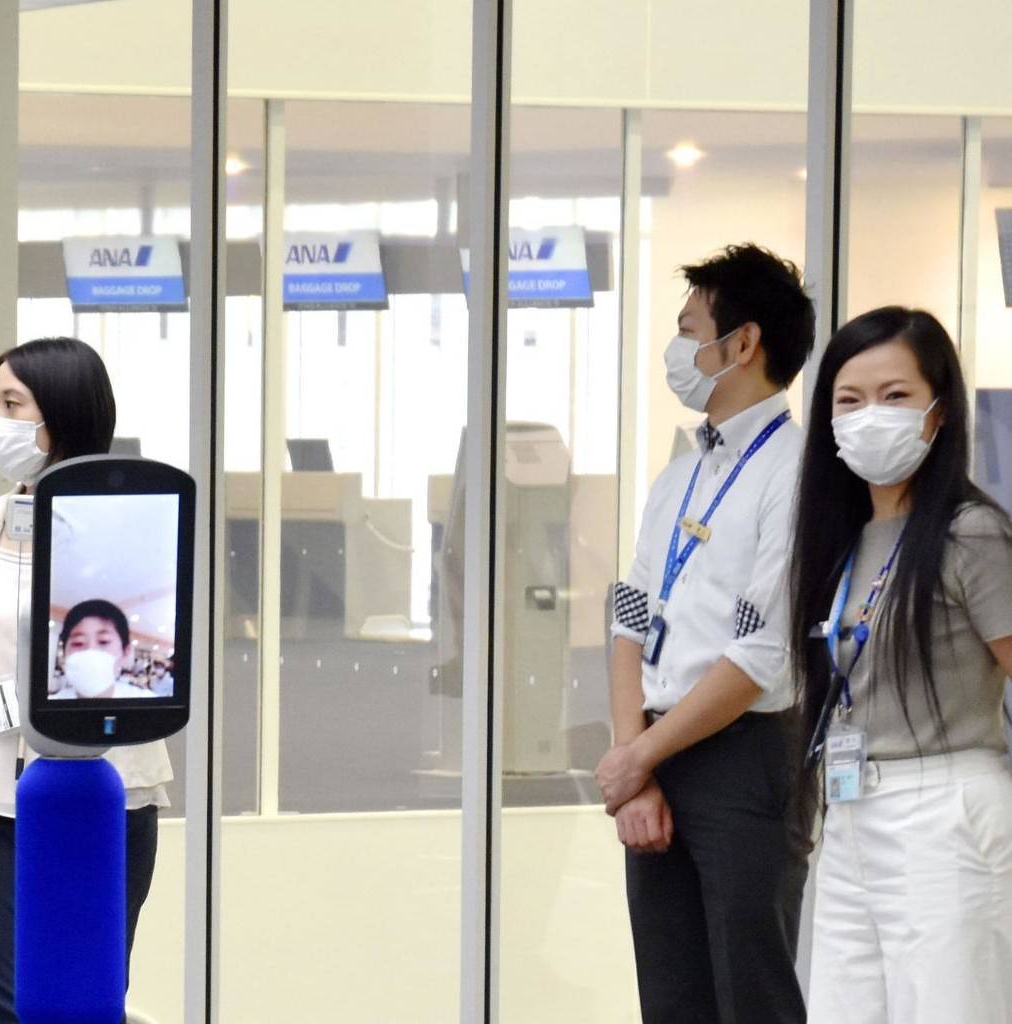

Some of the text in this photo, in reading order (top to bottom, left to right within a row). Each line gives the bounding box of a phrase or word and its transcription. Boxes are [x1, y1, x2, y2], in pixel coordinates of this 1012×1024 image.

[89, 247, 132, 268] ANA
[285, 244, 331, 265] ANA
[91, 284, 162, 297] BAGGAGE DROP
[288, 281, 361, 294] BAGGAGE DROP
[537, 279, 566, 291] DROP
